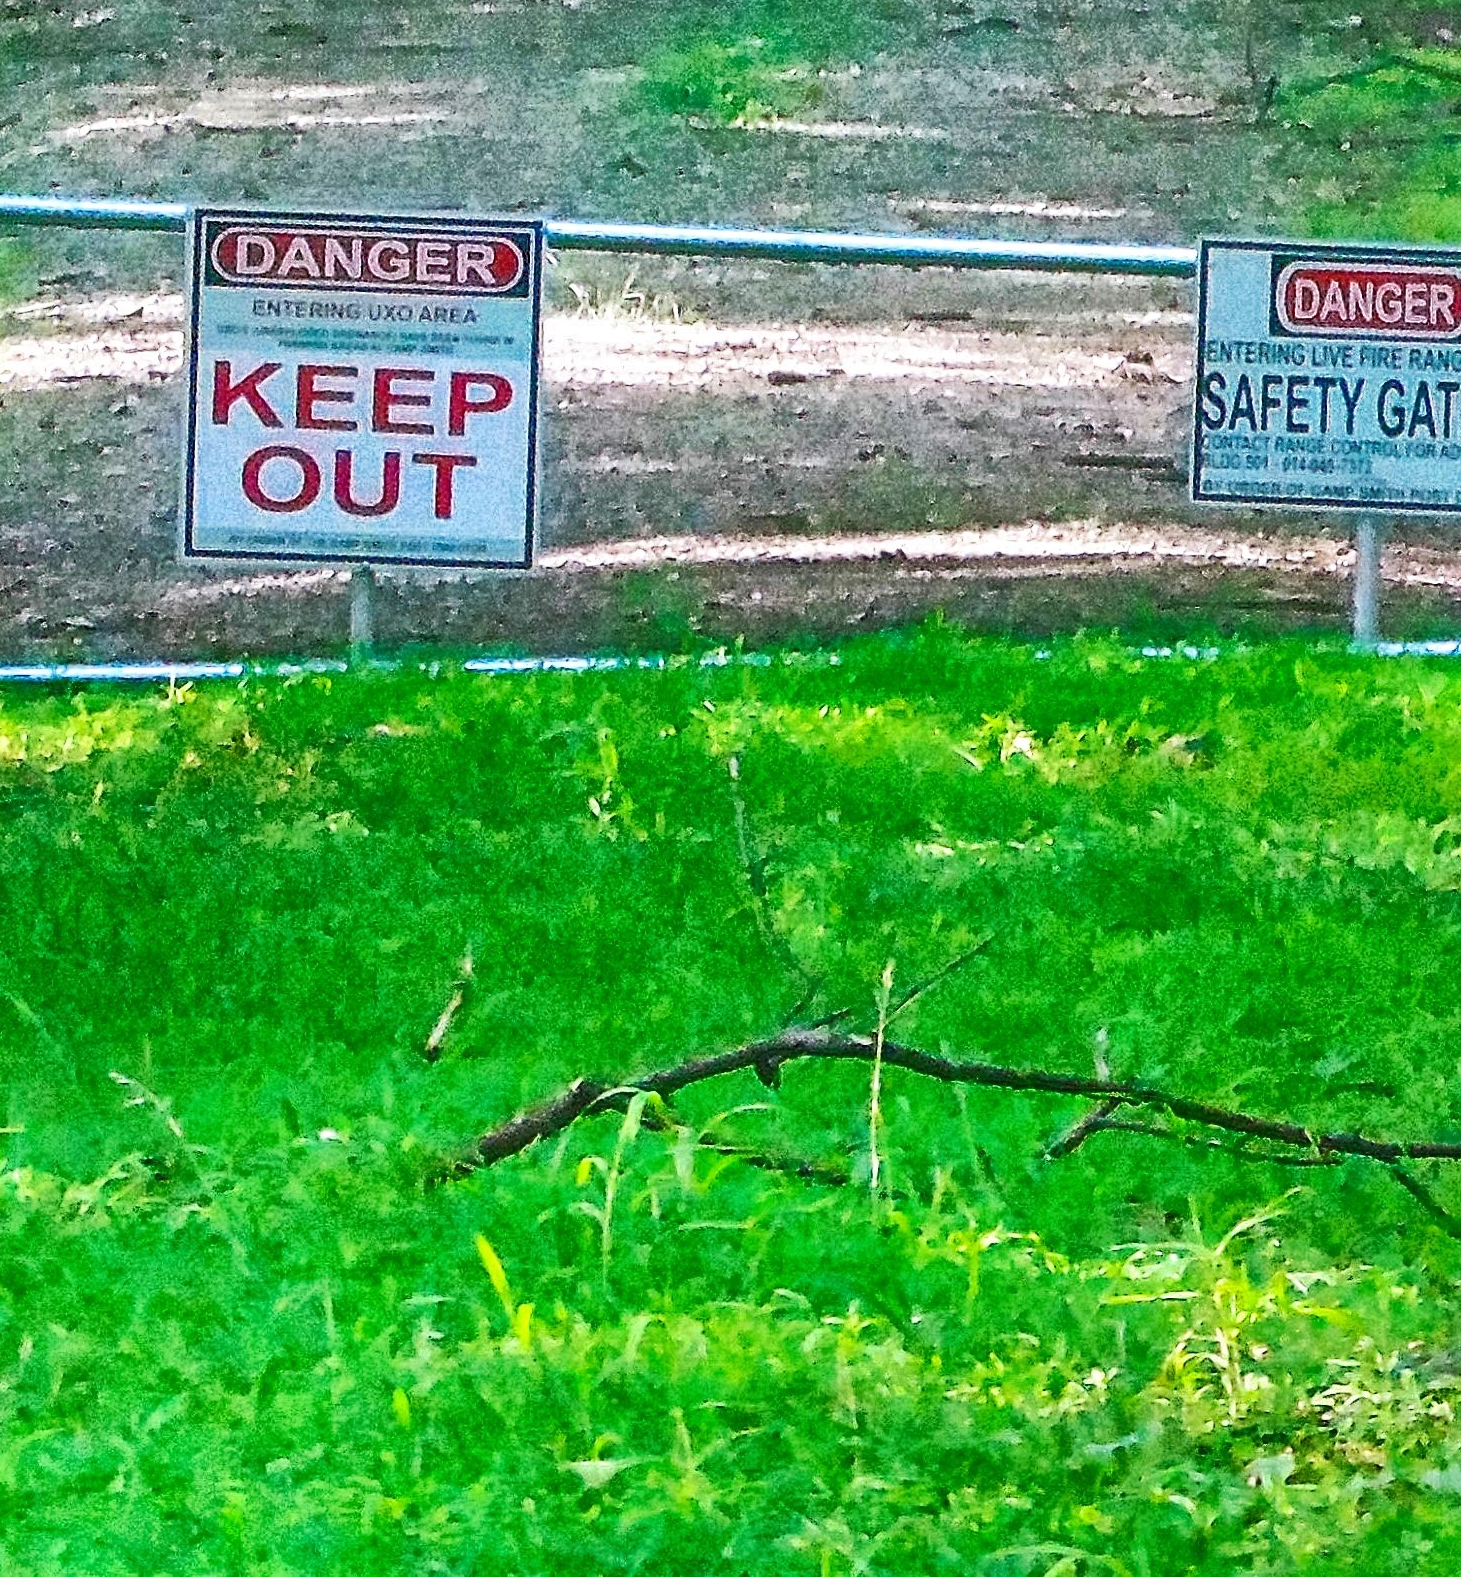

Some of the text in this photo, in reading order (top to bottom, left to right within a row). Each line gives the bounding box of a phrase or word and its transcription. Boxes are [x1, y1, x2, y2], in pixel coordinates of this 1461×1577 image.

[238, 235, 496, 284] DANGER
[252, 299, 477, 323] ENTERING UXO AREA
[1294, 279, 1455, 325] DANGER
[1205, 340, 1306, 366] ENTERING
[1311, 346, 1353, 369] LIVE
[1360, 348, 1402, 371] FIRE
[211, 360, 514, 437] KEEP
[1202, 372, 1365, 435] SAFETY
[1203, 433, 1269, 452] CONTACT
[1275, 436, 1325, 454] RANGE
[1332, 439, 1401, 458] CONTROL
[241, 445, 477, 519] OUT
